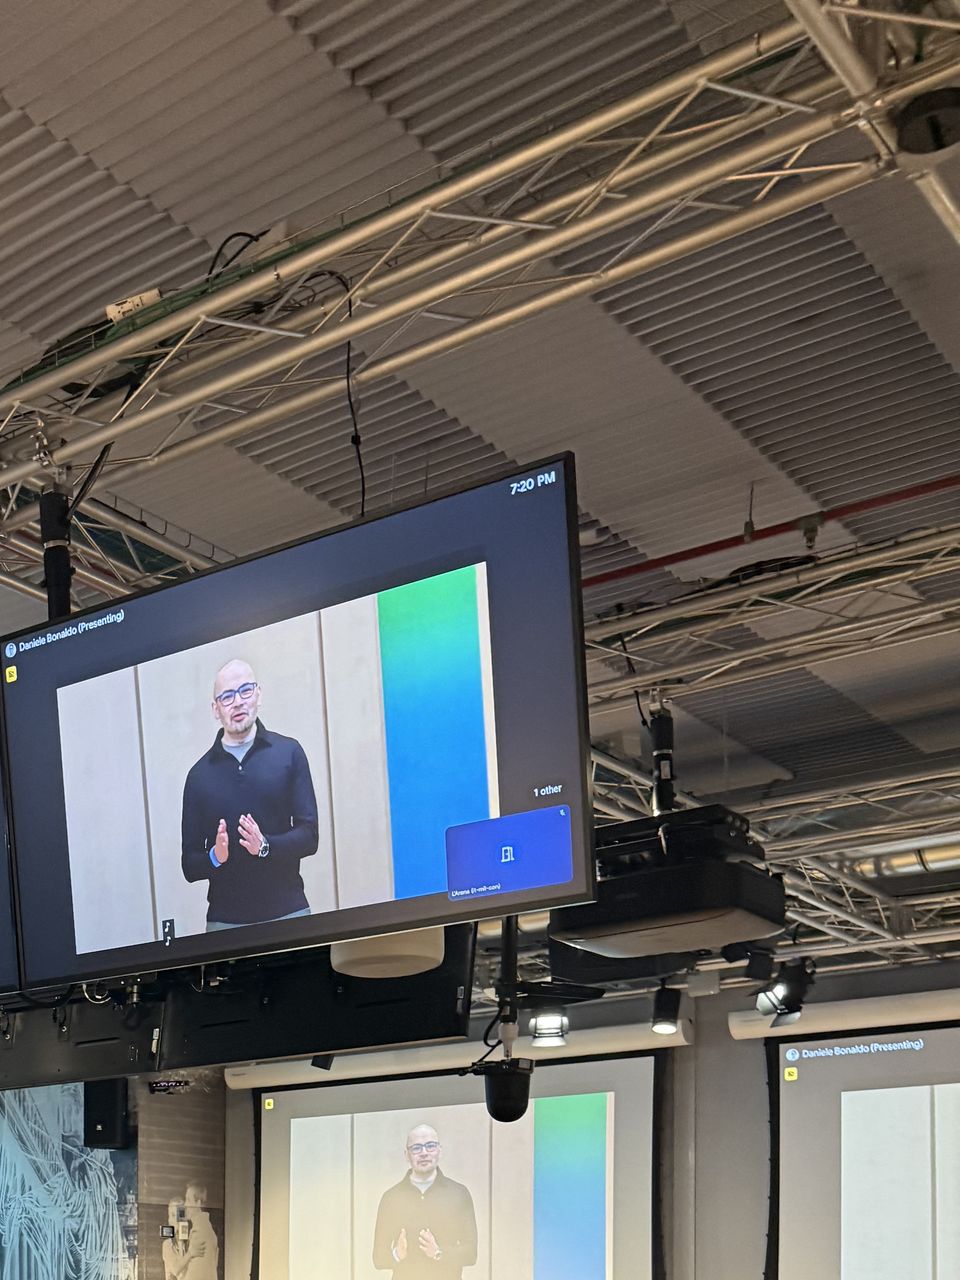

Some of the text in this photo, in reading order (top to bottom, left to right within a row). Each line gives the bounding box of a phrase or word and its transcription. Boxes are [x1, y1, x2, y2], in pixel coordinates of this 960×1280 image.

[510, 471, 556, 495] 7:20 PM
[19, 609, 125, 652] Daniele Bonaldo (Presenting)
[533, 784, 563, 797] 1 other
[802, 1038, 925, 1058] Daniele Bonaldo (Presenting)
